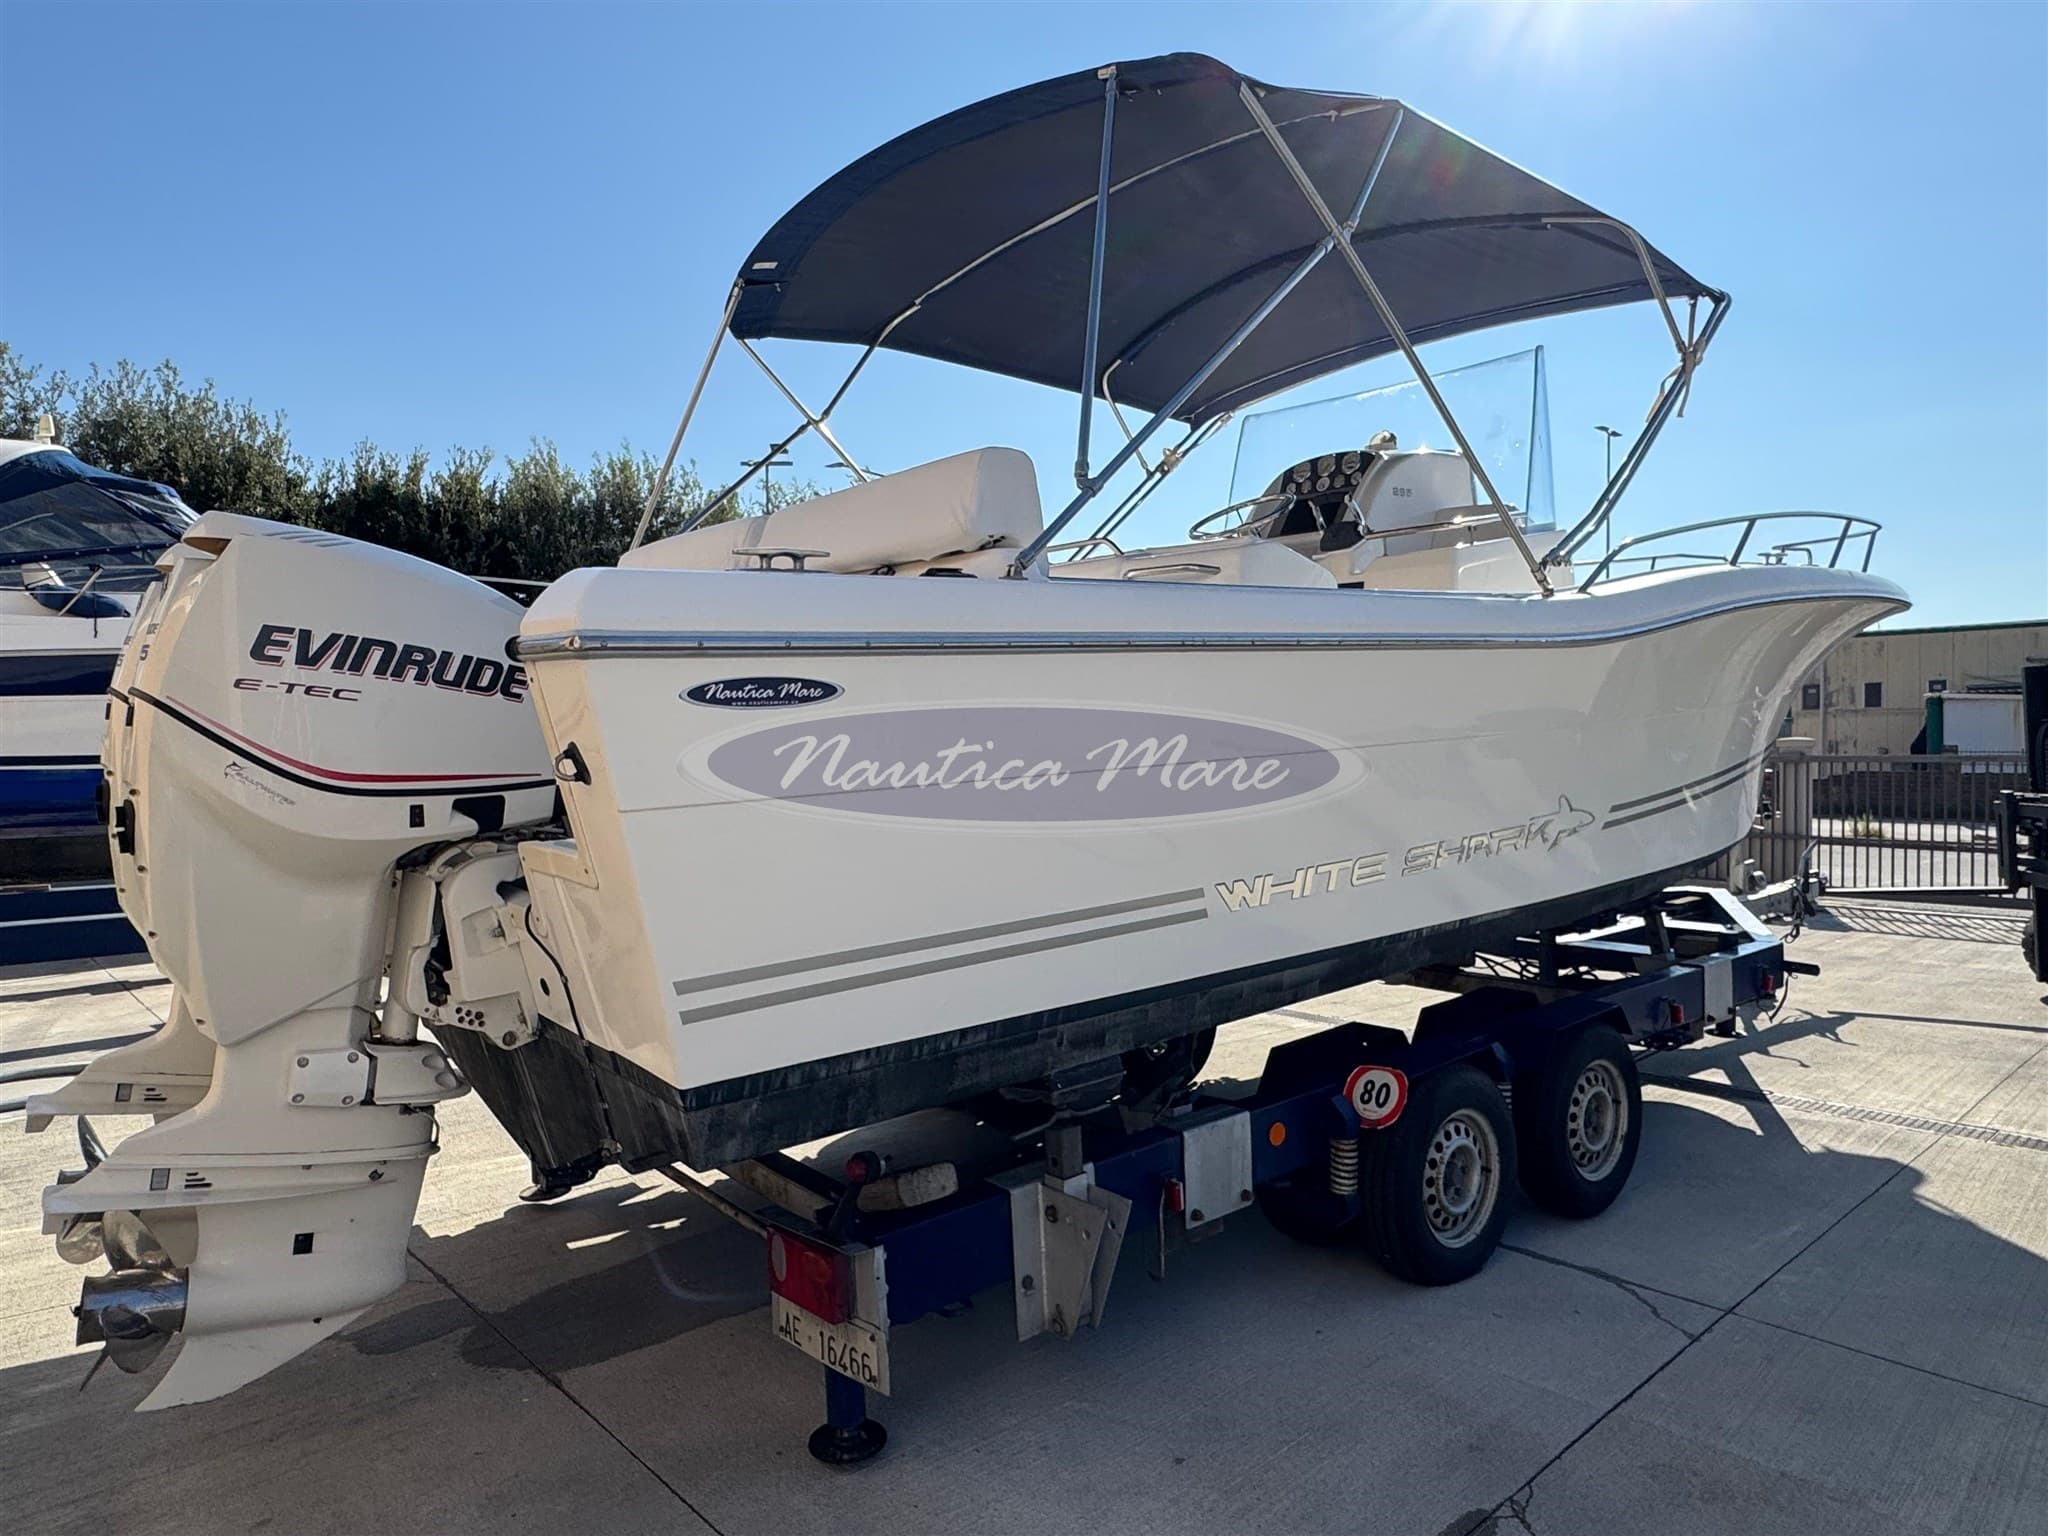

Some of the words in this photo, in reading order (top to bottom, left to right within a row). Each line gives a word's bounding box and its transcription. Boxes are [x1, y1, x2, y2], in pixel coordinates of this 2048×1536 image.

[249, 623, 528, 703] EVINRUDE
[233, 678, 362, 701] E-TEC
[704, 683, 775, 700] Nautica
[777, 682, 824, 698] Mare
[1215, 852, 1390, 912] WHITE
[1401, 817, 1554, 877] SHARK
[1360, 1079, 1391, 1109] 80
[784, 1312, 802, 1347] AE
[819, 1330, 873, 1383] 16466
